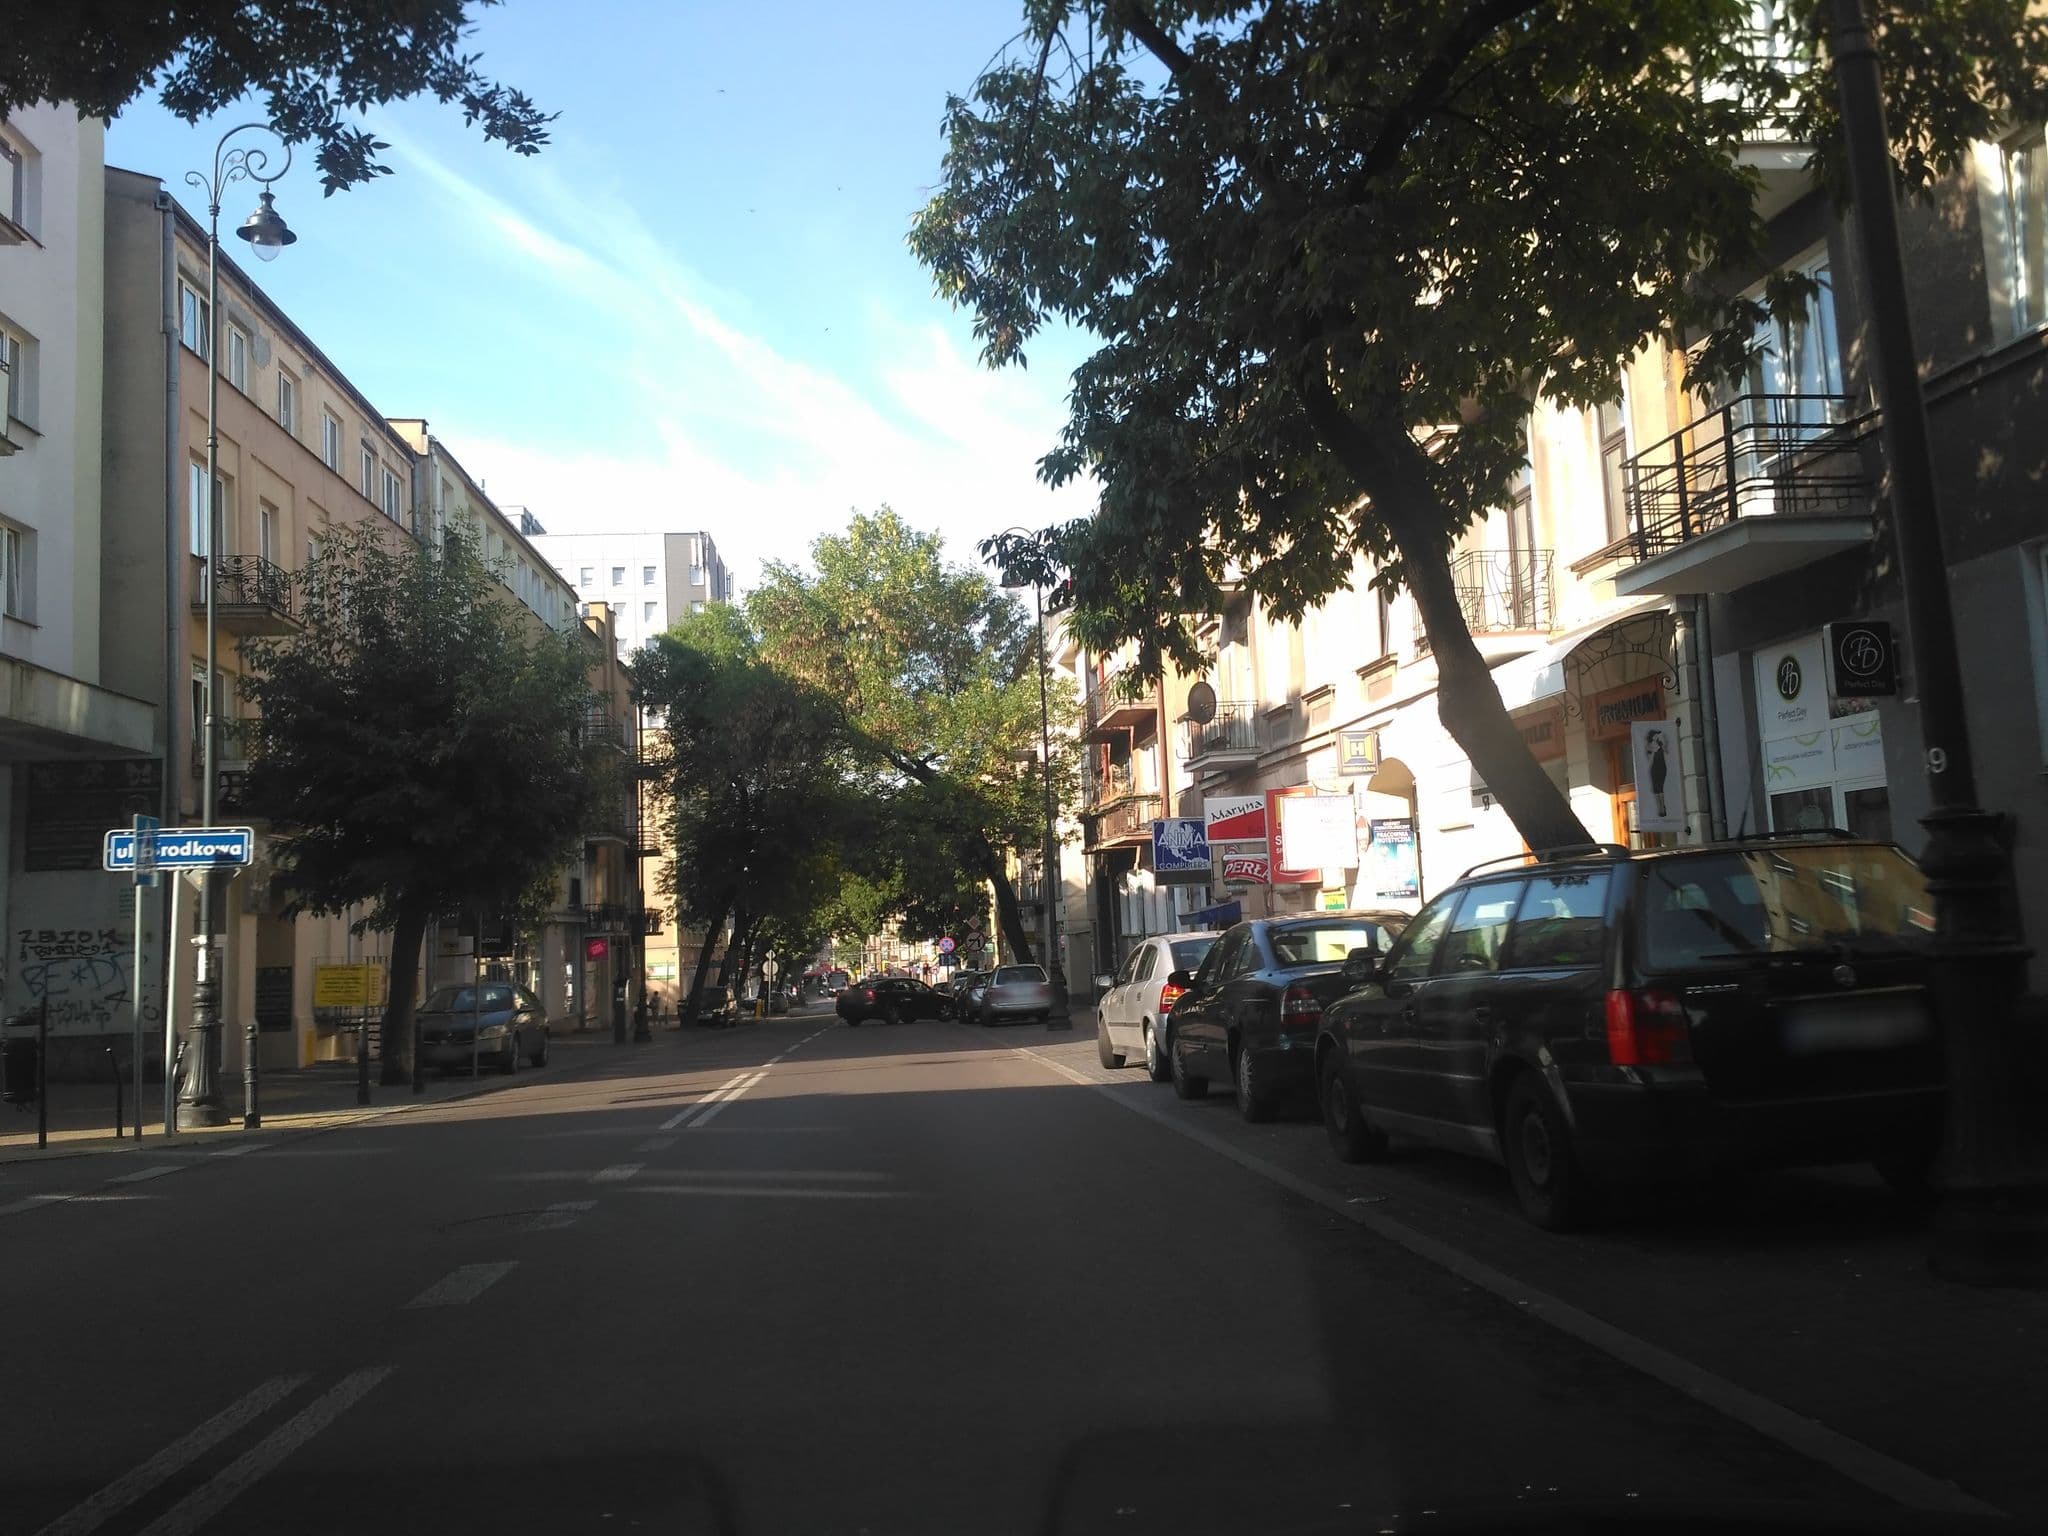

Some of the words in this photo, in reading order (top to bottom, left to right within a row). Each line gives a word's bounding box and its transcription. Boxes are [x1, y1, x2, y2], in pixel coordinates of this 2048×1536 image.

[1211, 800, 1263, 822] Maryna
[157, 839, 242, 858] rodkowa
[1159, 860, 1209, 873] COMPUTERS
